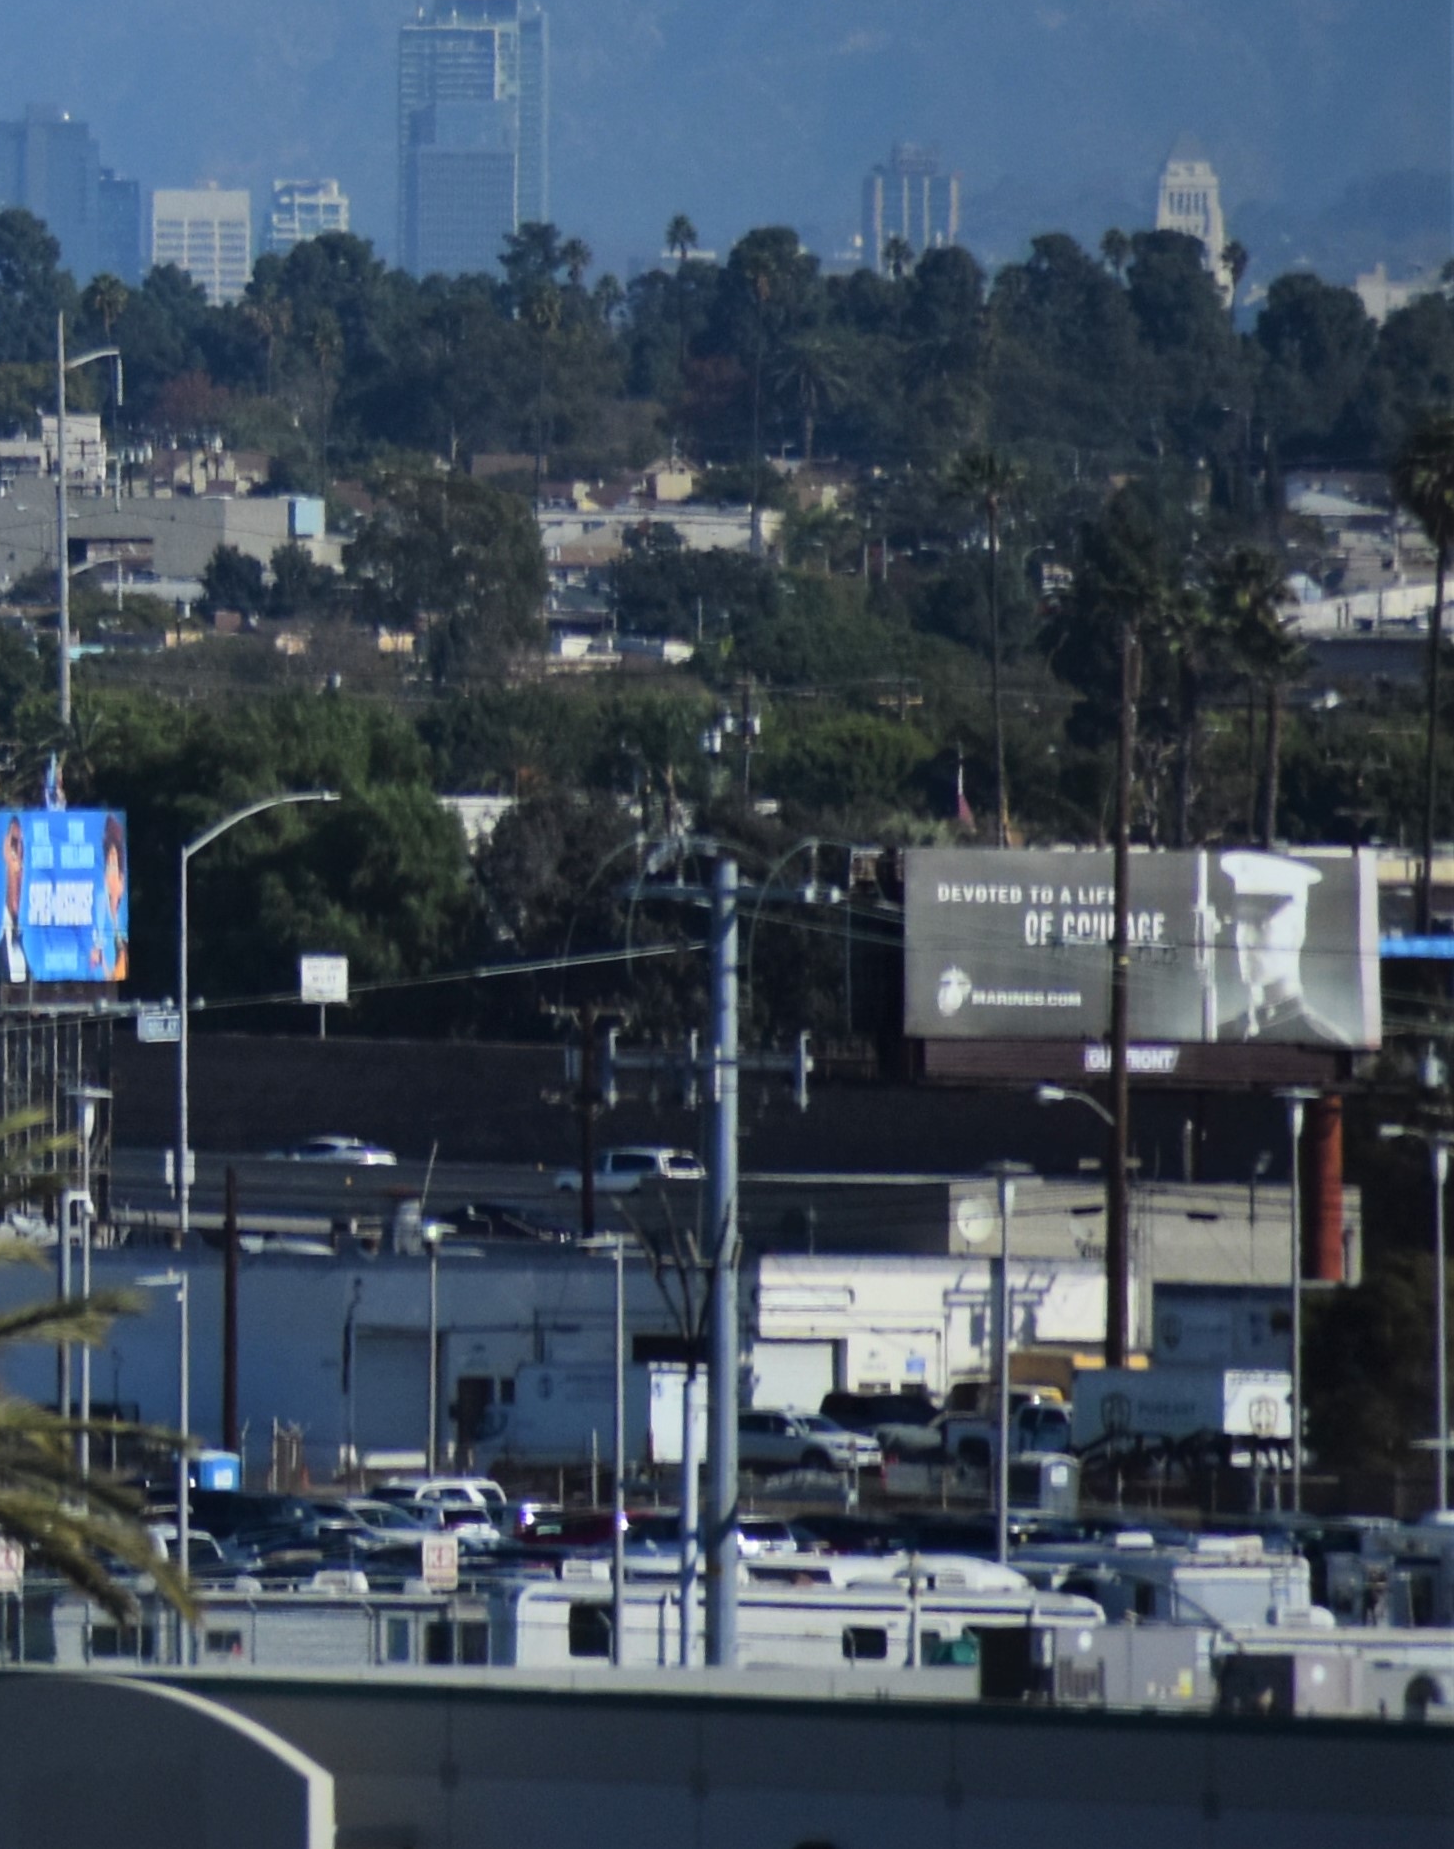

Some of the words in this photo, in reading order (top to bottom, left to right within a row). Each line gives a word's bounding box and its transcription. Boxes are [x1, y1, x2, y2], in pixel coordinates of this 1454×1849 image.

[937, 883, 1022, 904] DEVOTED
[1029, 886, 1054, 904] TO
[1060, 886, 1071, 905] A
[1024, 911, 1054, 945] OF
[1062, 912, 1166, 944] COUAGE
[971, 989, 1081, 1007] MARINES.COM
[1088, 1050, 1174, 1069] OURONT
